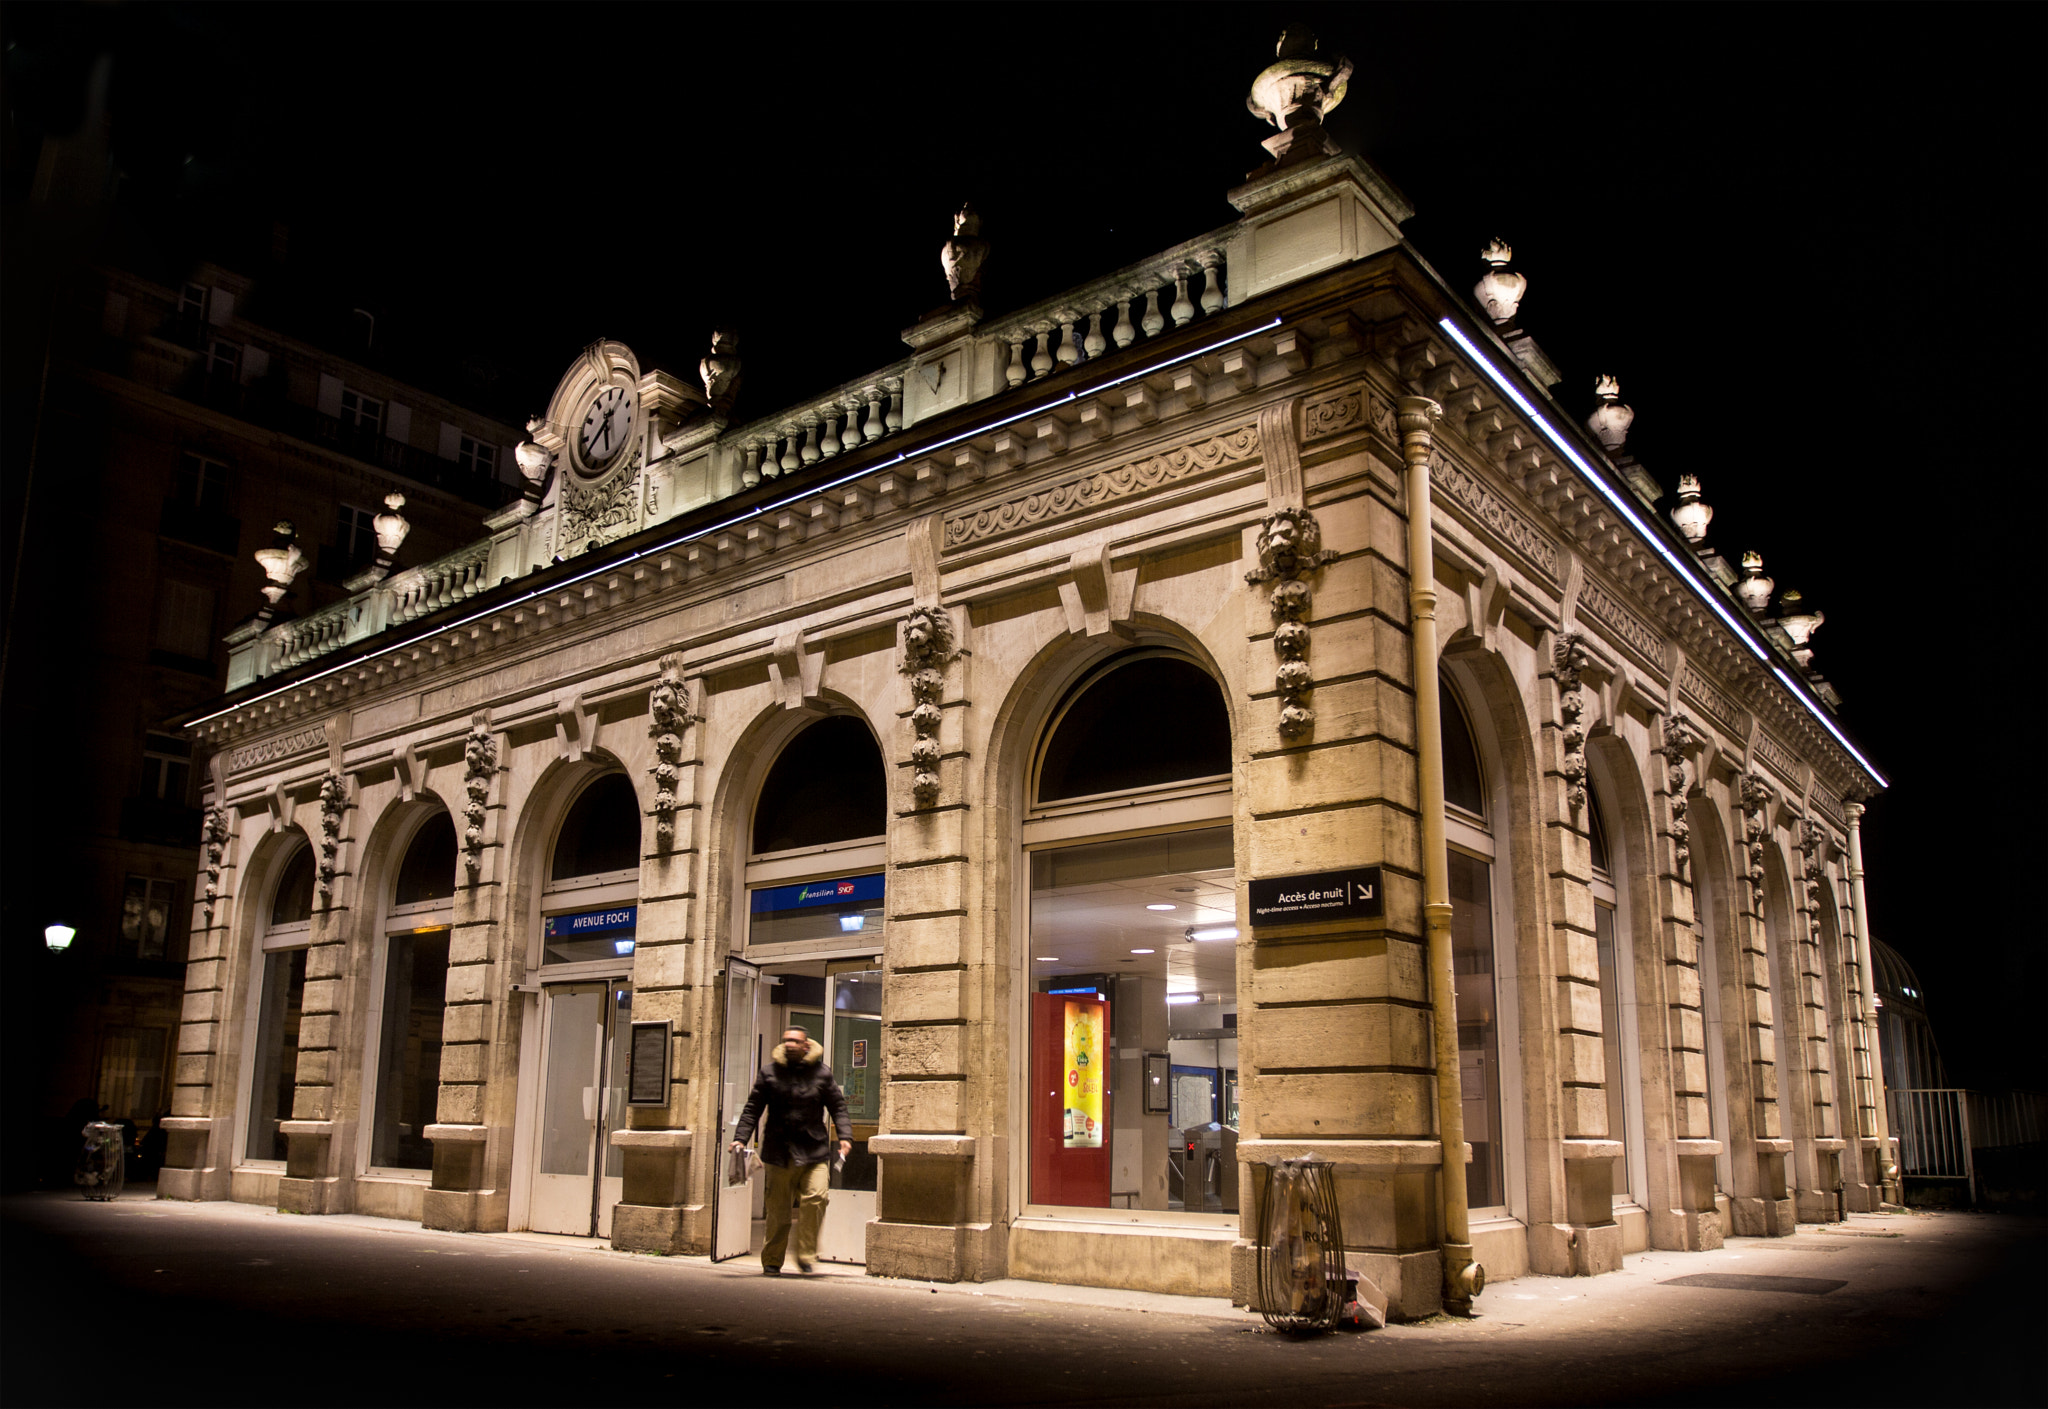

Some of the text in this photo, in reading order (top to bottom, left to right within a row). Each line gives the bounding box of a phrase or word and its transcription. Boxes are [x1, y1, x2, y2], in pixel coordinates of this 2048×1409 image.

[802, 886, 854, 898] Transilien SNCF
[1278, 887, 1344, 903] Accès de nuit
[1256, 907, 1282, 915] Night-time
[573, 912, 629, 928] AVENUE FOCH
